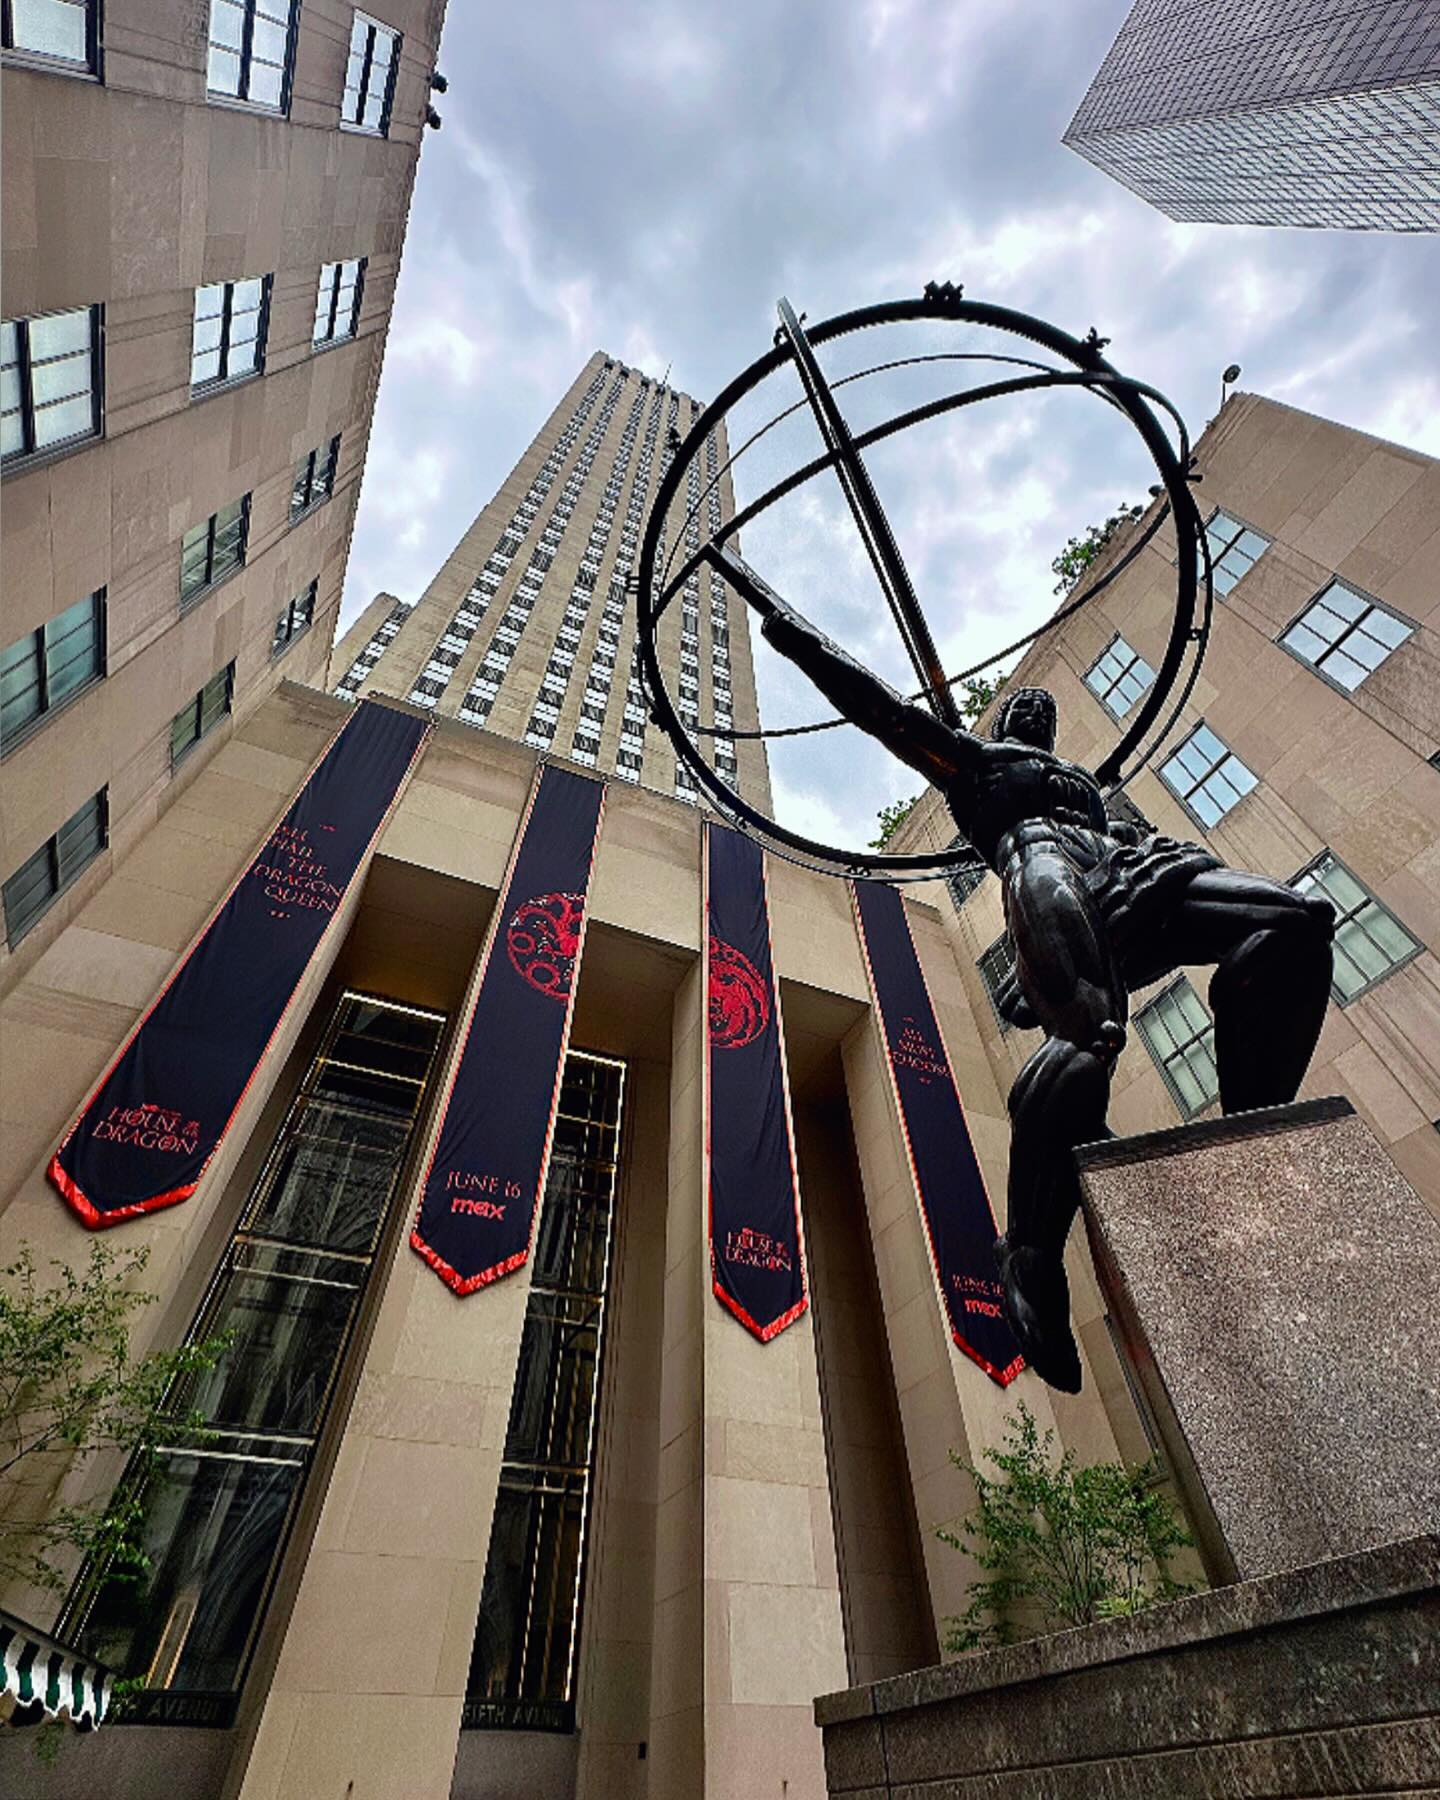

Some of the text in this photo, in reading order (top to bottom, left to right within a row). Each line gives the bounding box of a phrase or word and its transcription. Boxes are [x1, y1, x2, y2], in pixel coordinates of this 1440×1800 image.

[288, 856, 328, 877] THE
[253, 864, 345, 898] DRAGON
[264, 885, 336, 913] QUEEN
[92, 1120, 199, 1155] DRAGON
[445, 1170, 521, 1199] JUNE 16
[451, 1198, 506, 1221] max
[964, 1298, 1004, 1319] max
[463, 1704, 506, 1725] FIFTH
